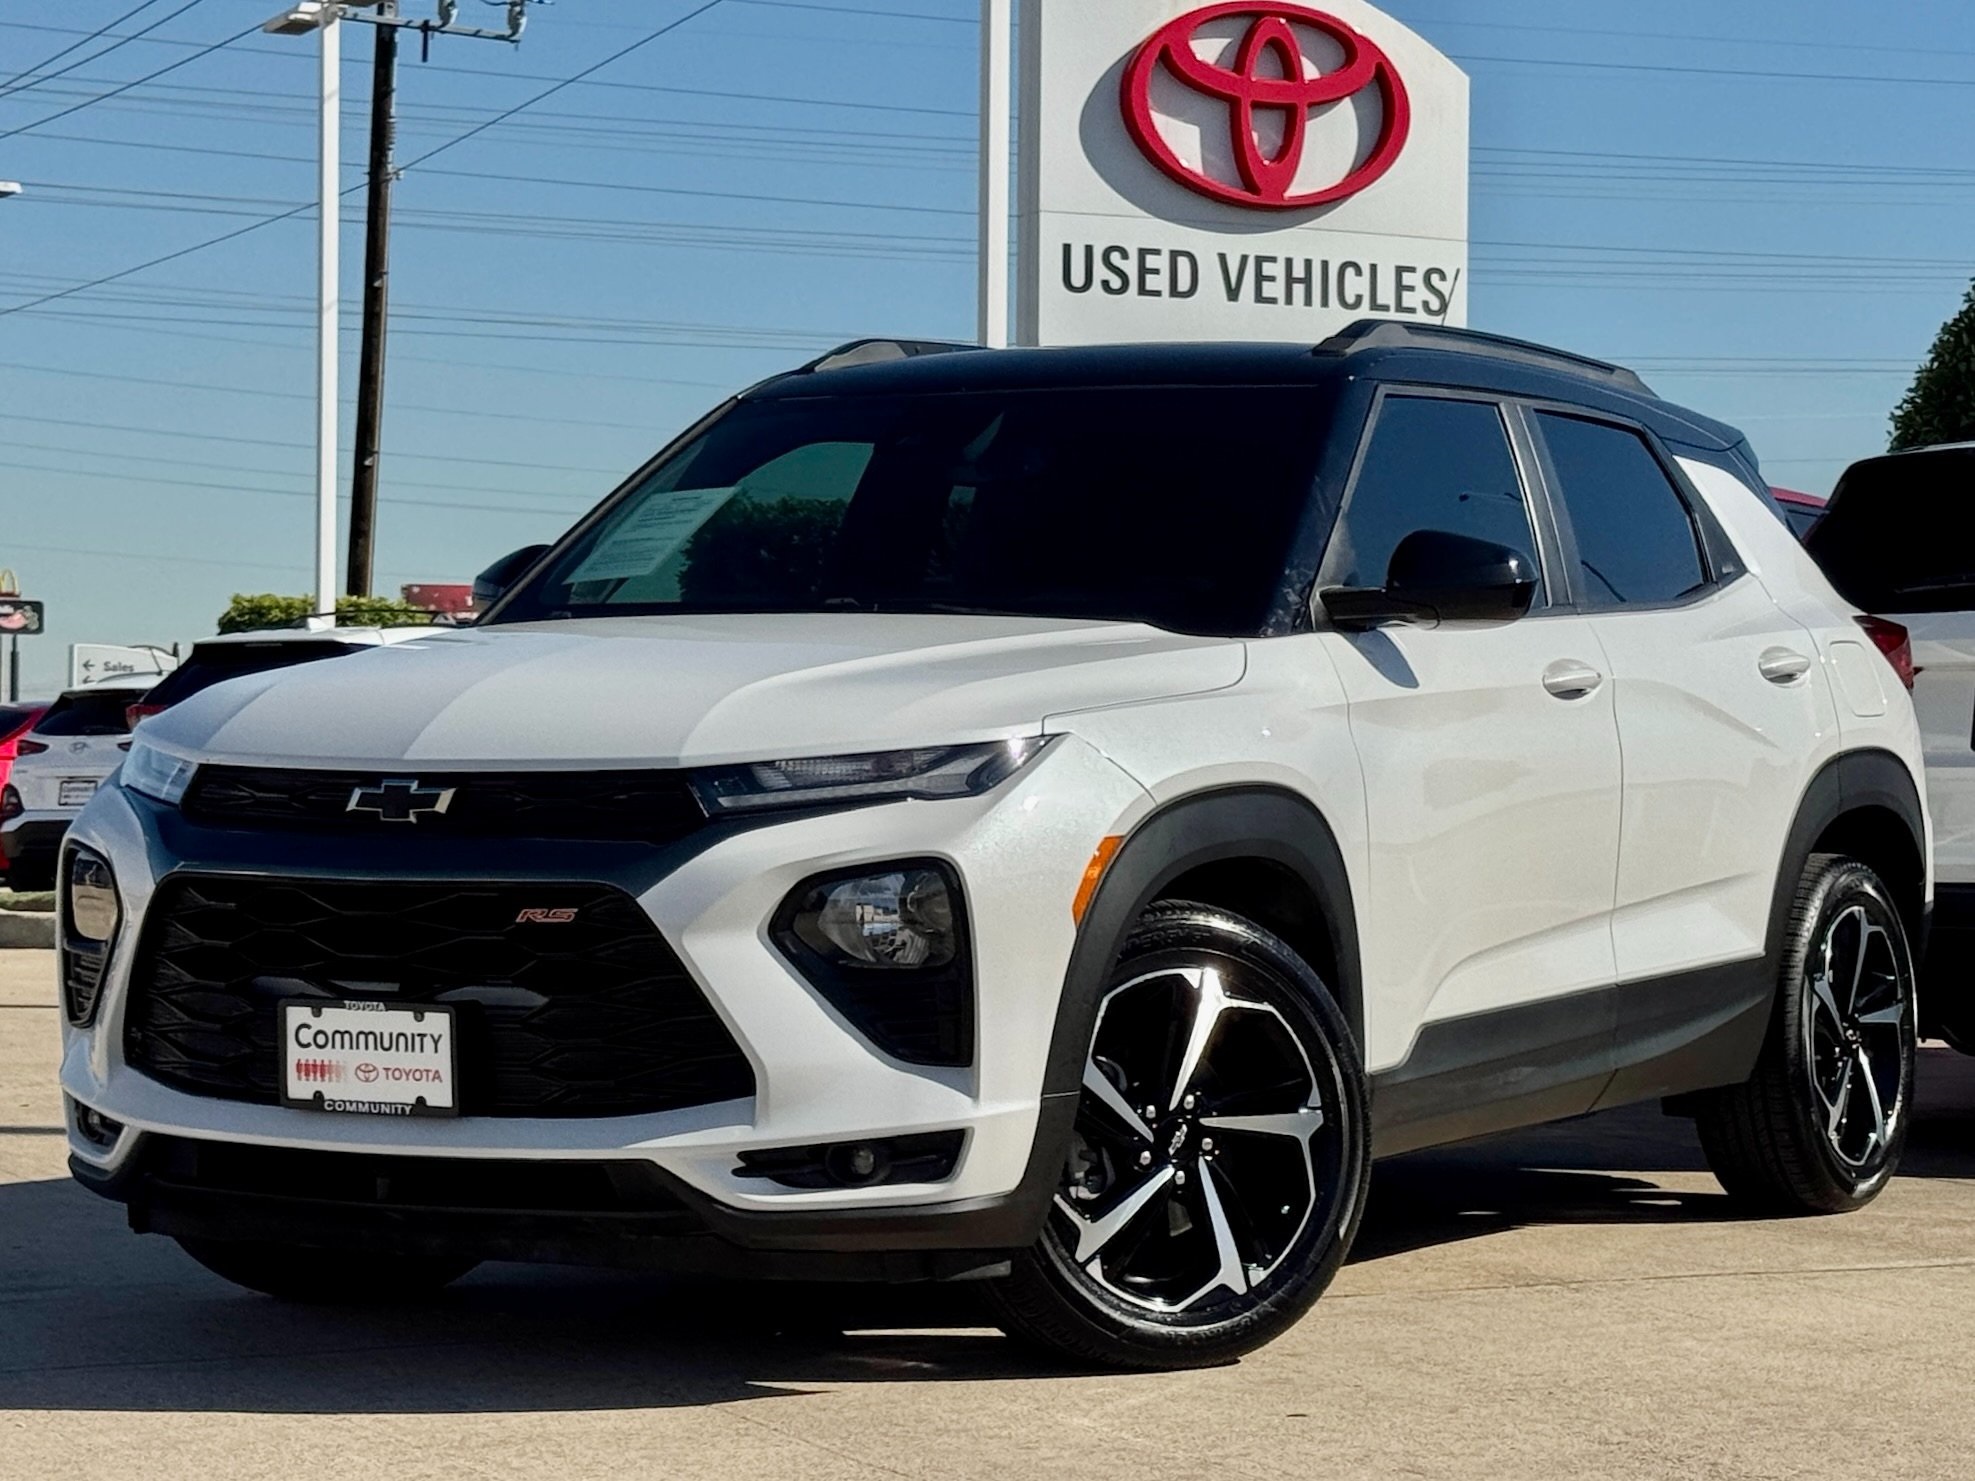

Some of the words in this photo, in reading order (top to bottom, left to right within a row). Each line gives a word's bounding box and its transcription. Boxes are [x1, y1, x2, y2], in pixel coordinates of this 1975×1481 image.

[1061, 243, 1199, 299] USED
[1217, 252, 1449, 317] VEHICLES
[103, 661, 135, 673] Sales
[515, 908, 579, 923] RS
[343, 1000, 387, 1012] TOYOTA
[382, 1067, 443, 1083] TOYOTA
[324, 1100, 413, 1116] COMMUNITY
